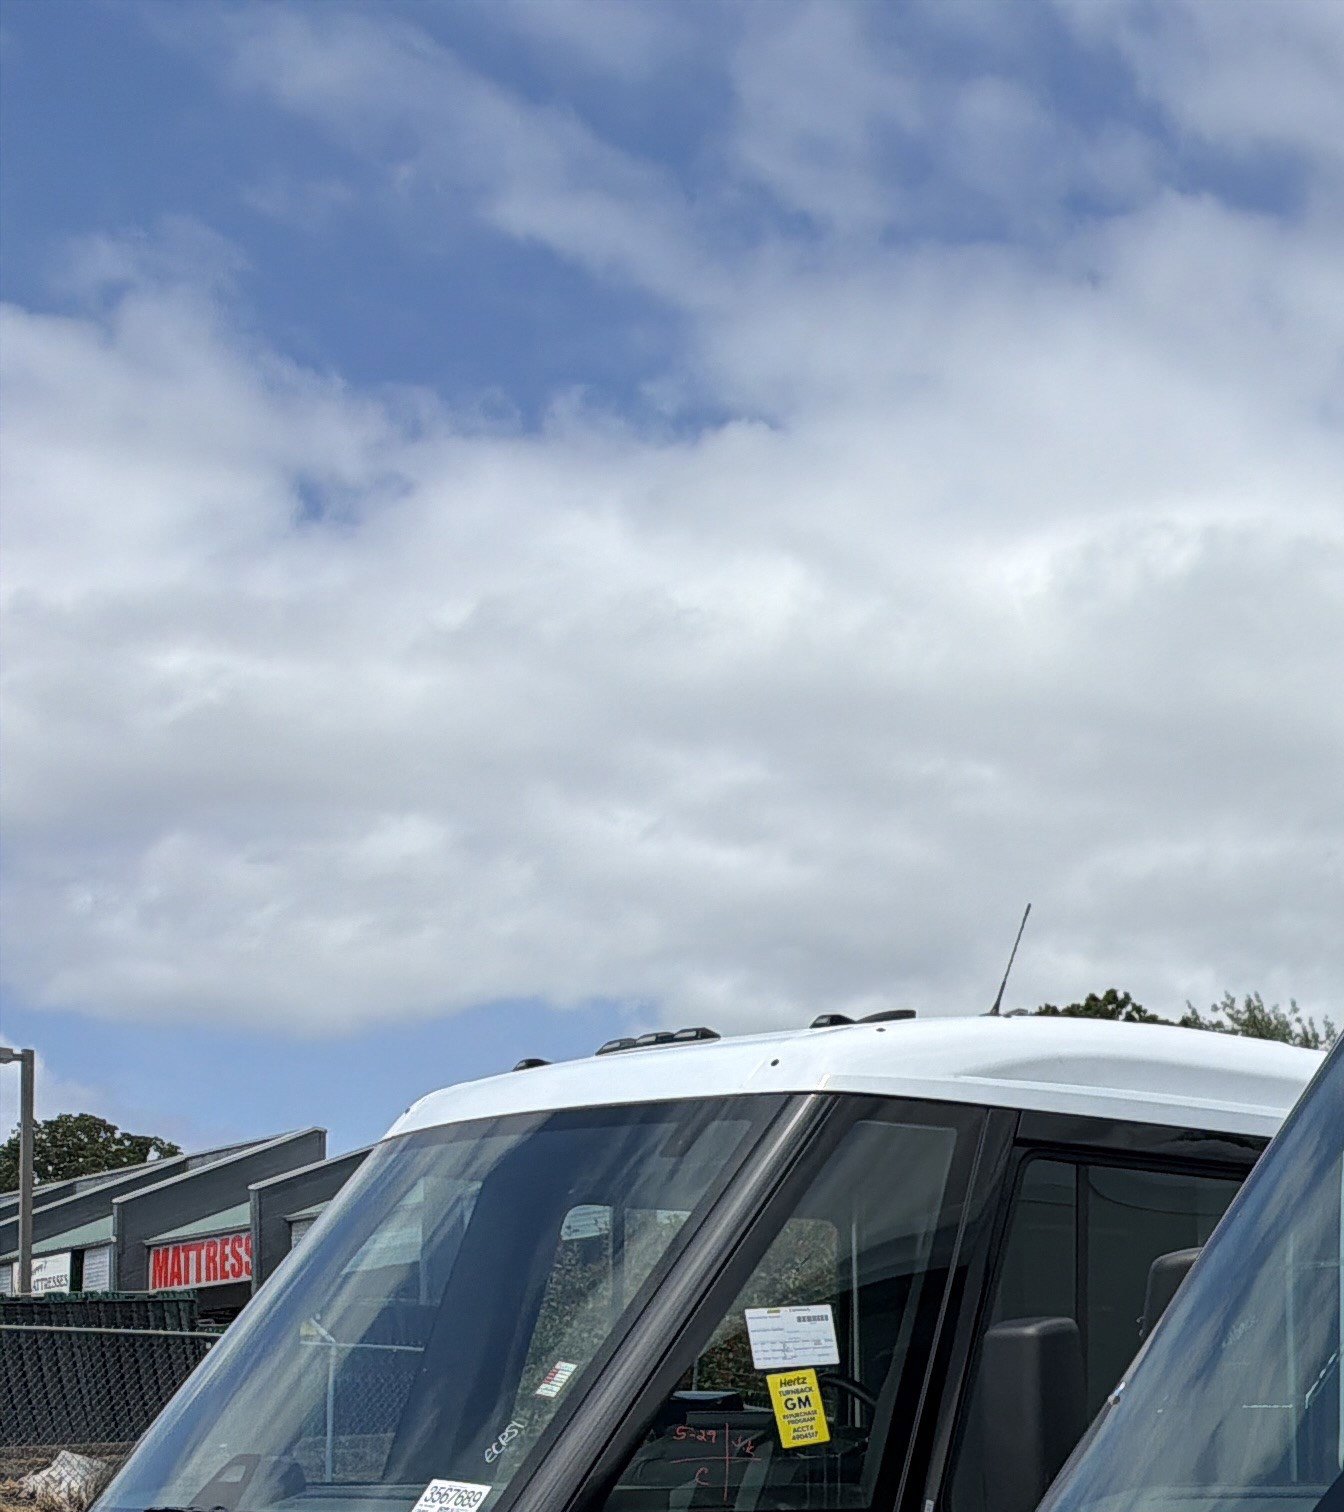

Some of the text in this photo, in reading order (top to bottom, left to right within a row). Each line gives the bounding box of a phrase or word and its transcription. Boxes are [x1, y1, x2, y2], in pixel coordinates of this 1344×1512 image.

[779, 1376, 808, 1388] Hertz
[784, 1395, 812, 1411] GM
[424, 1485, 483, 1508] 3567689
